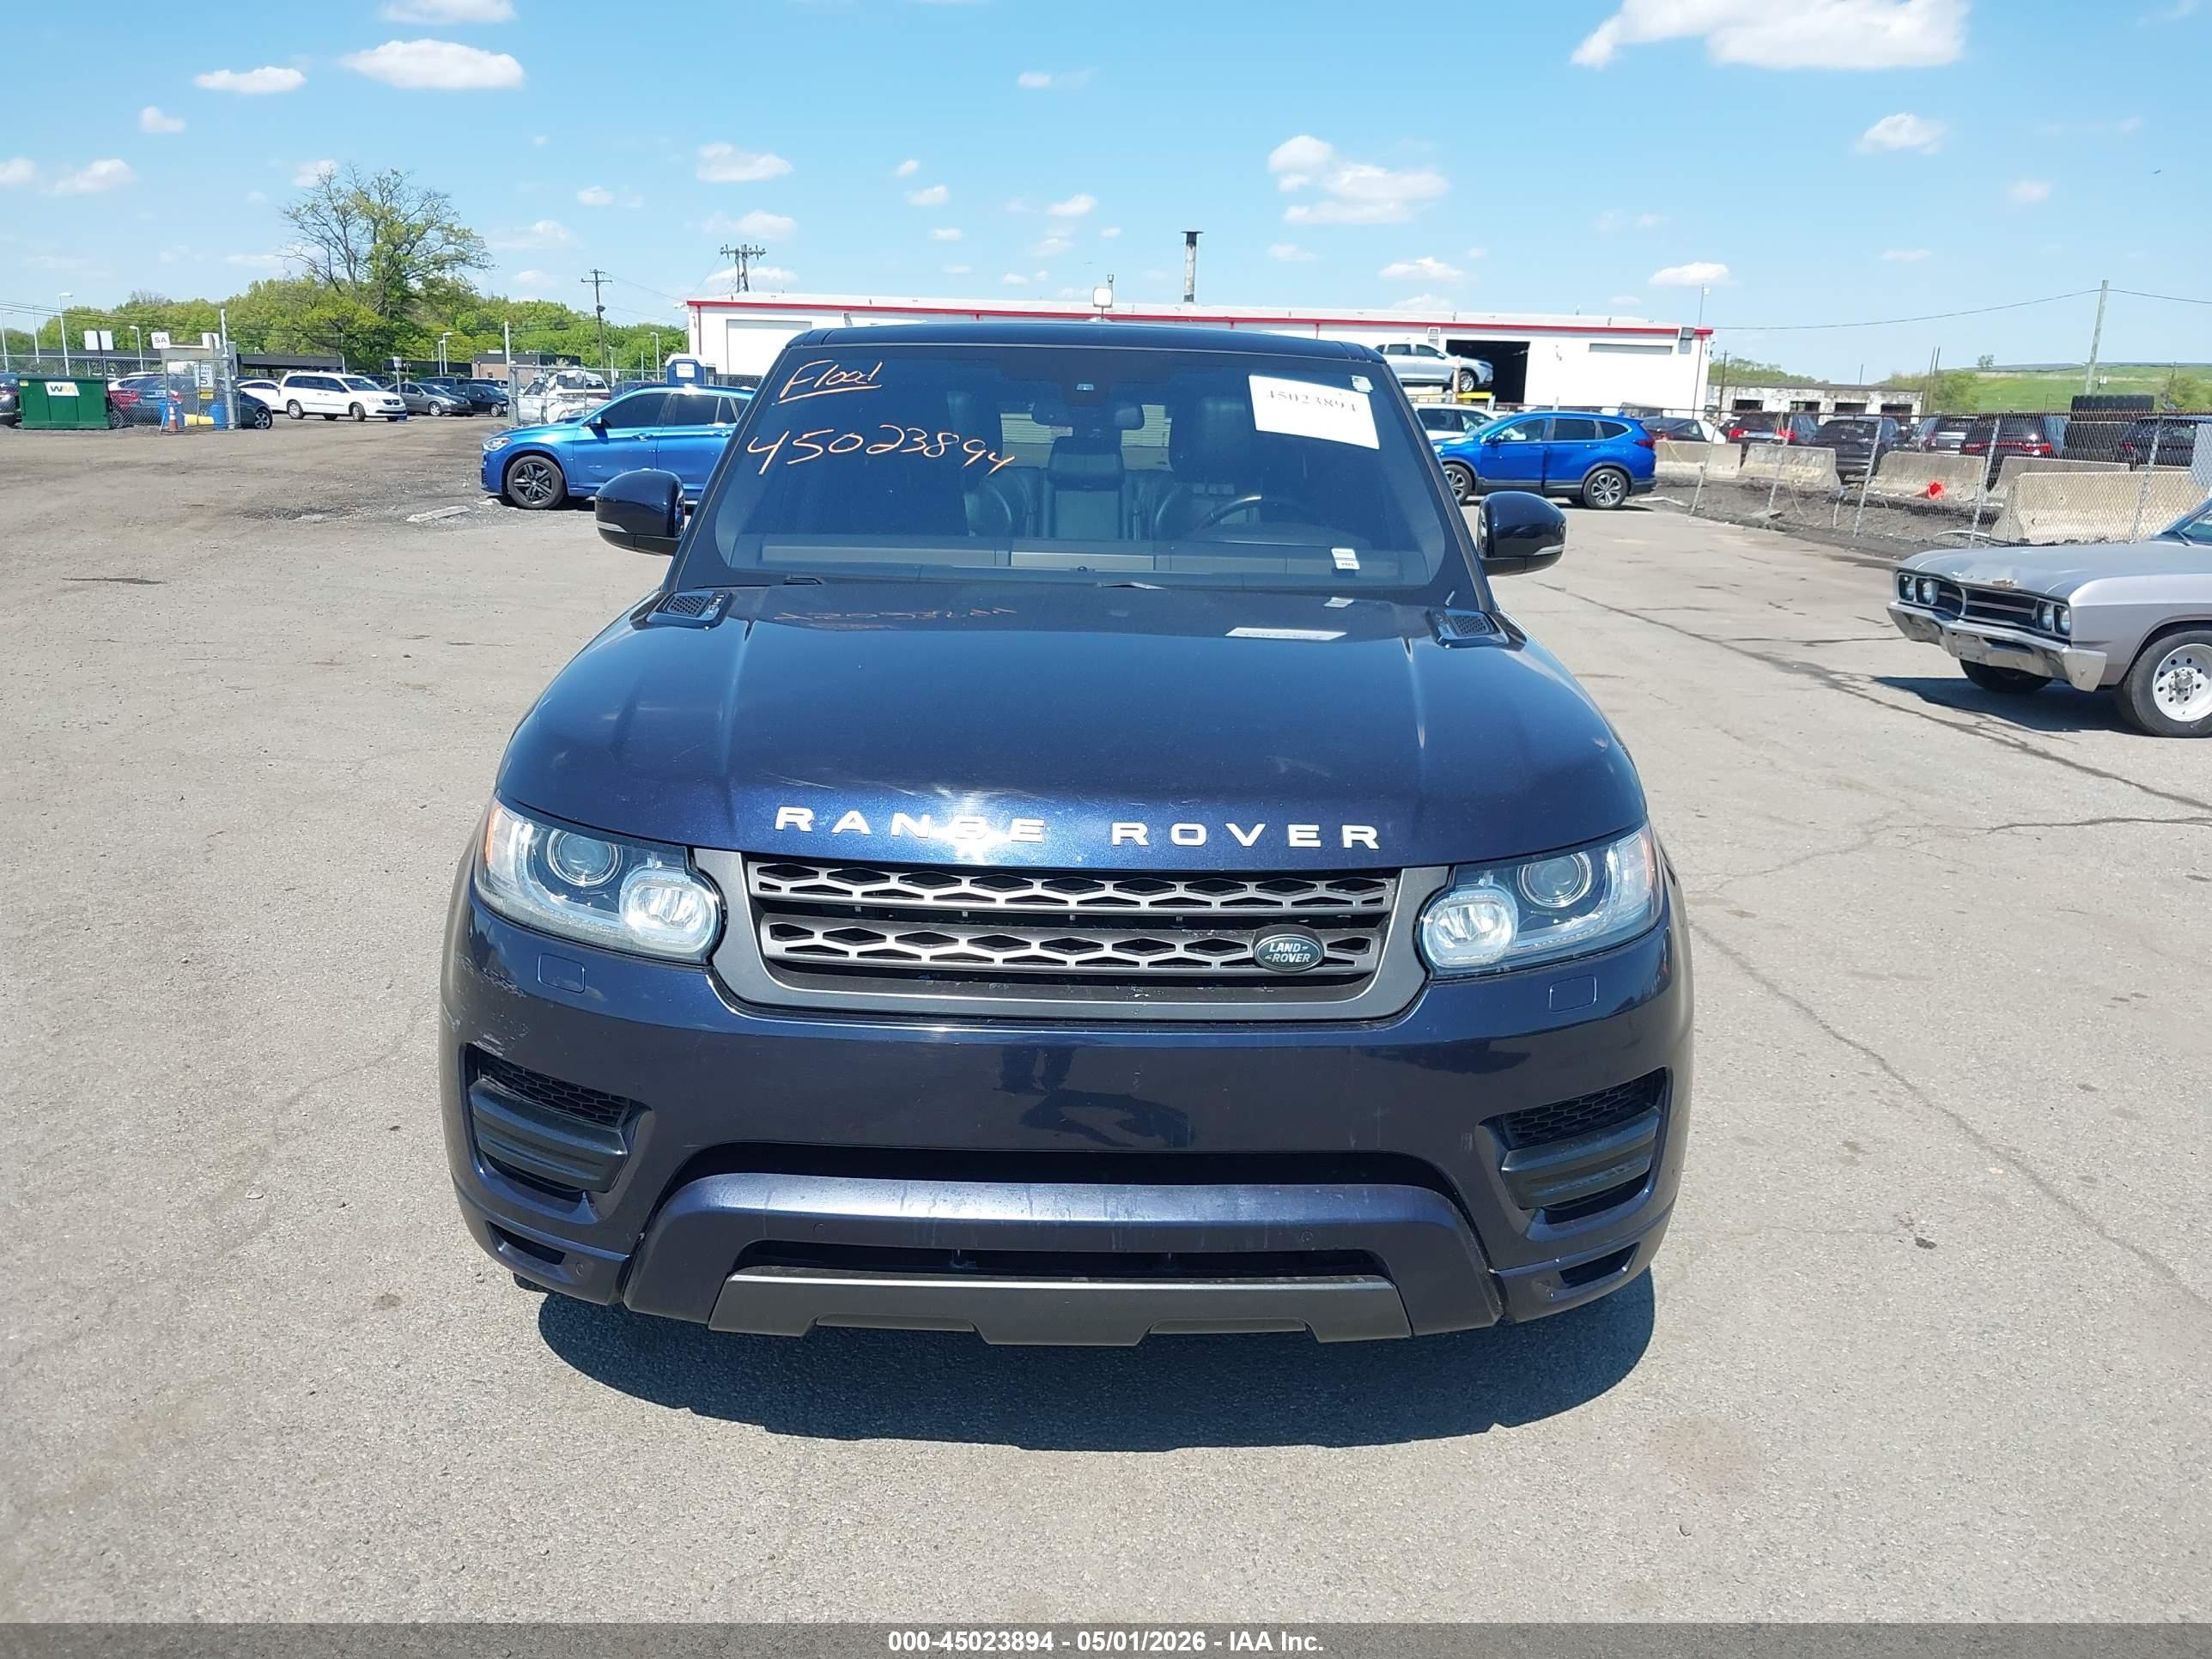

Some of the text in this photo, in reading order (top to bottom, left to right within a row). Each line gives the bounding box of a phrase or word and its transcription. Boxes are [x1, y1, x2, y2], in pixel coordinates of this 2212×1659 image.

[200, 376, 208, 385] 5
[779, 359, 884, 398] Flood
[747, 425, 1017, 476] 45023894
[1111, 822, 1380, 849] ROVER
[1268, 942, 1301, 952] LAND
[1271, 952, 1311, 963] ROVER
